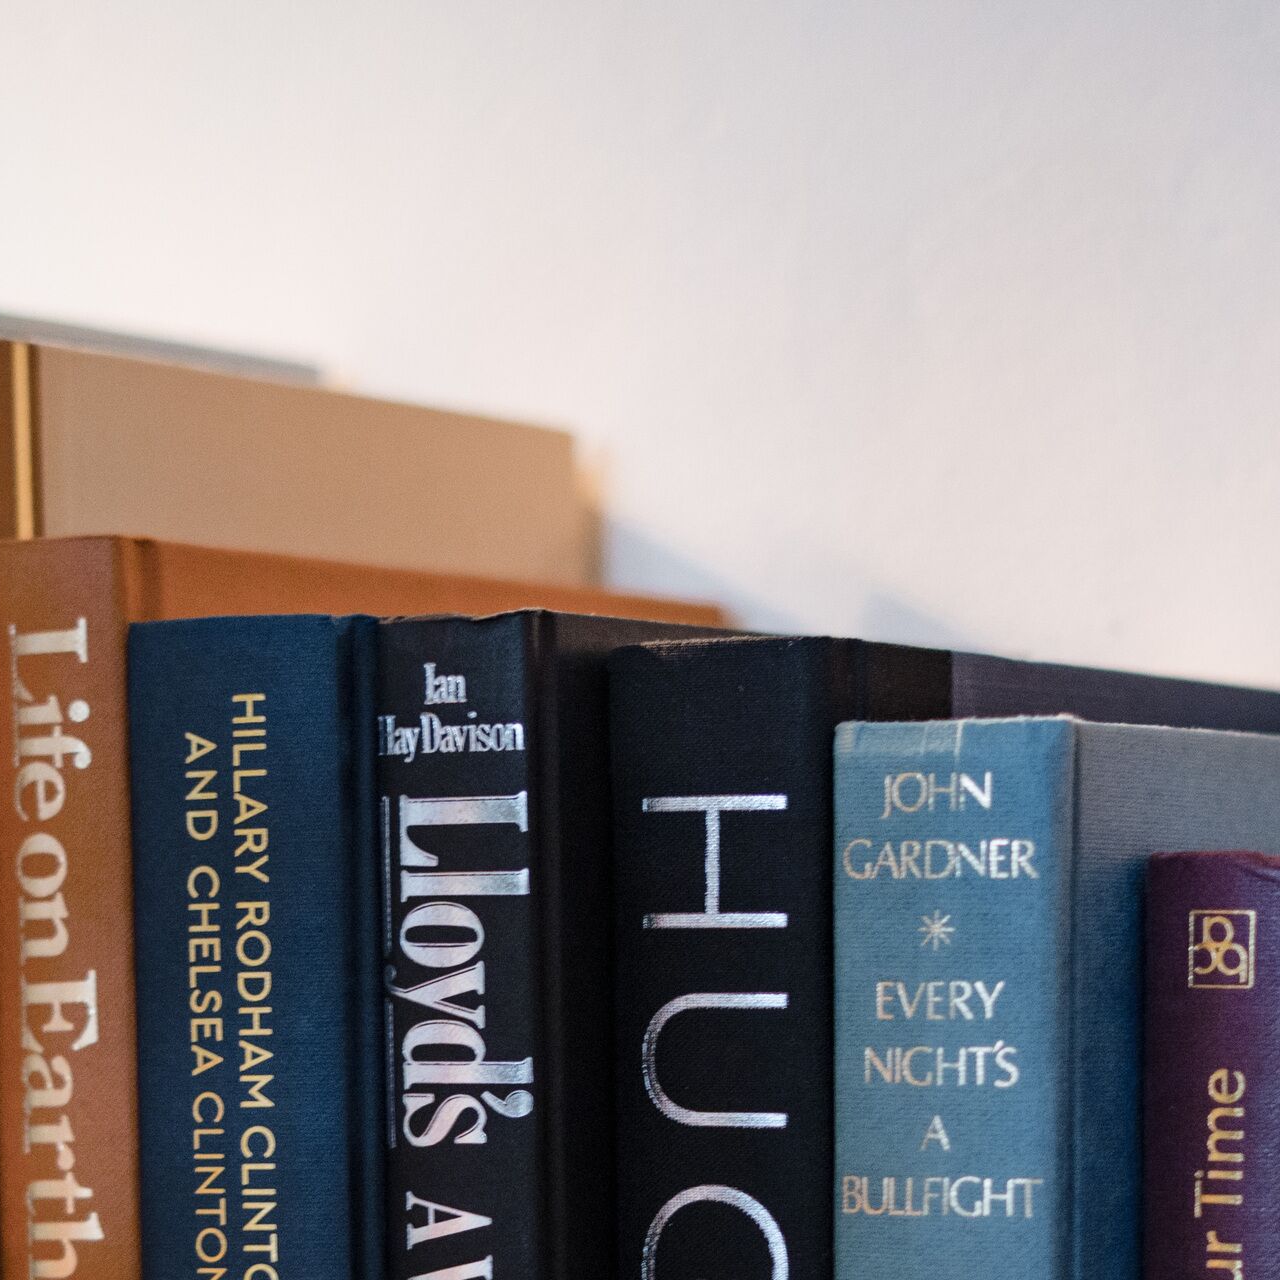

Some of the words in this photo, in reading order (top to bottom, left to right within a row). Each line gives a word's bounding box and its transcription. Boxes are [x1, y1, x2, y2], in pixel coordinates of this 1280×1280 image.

[423, 662, 468, 705] Ian
[7, 617, 93, 821] Life
[378, 714, 420, 763] Hay
[420, 711, 526, 755] Davison
[184, 732, 220, 842] AND
[232, 692, 270, 883] HILLARY
[880, 771, 993, 820] JOHN
[842, 838, 1040, 880] GARDNER
[15, 833, 70, 961] on
[186, 864, 224, 1078] CHELSEA
[386, 791, 534, 1148] Lloyd's
[236, 900, 276, 1109] RODHAM
[876, 980, 1006, 1021] EVERY
[864, 1040, 1021, 1088] NIGHT'S
[921, 1115, 951, 1151] A
[1194, 1067, 1246, 1218] Time
[406, 1191, 494, 1250] A
[841, 1175, 1045, 1219] BULLFIGHT
